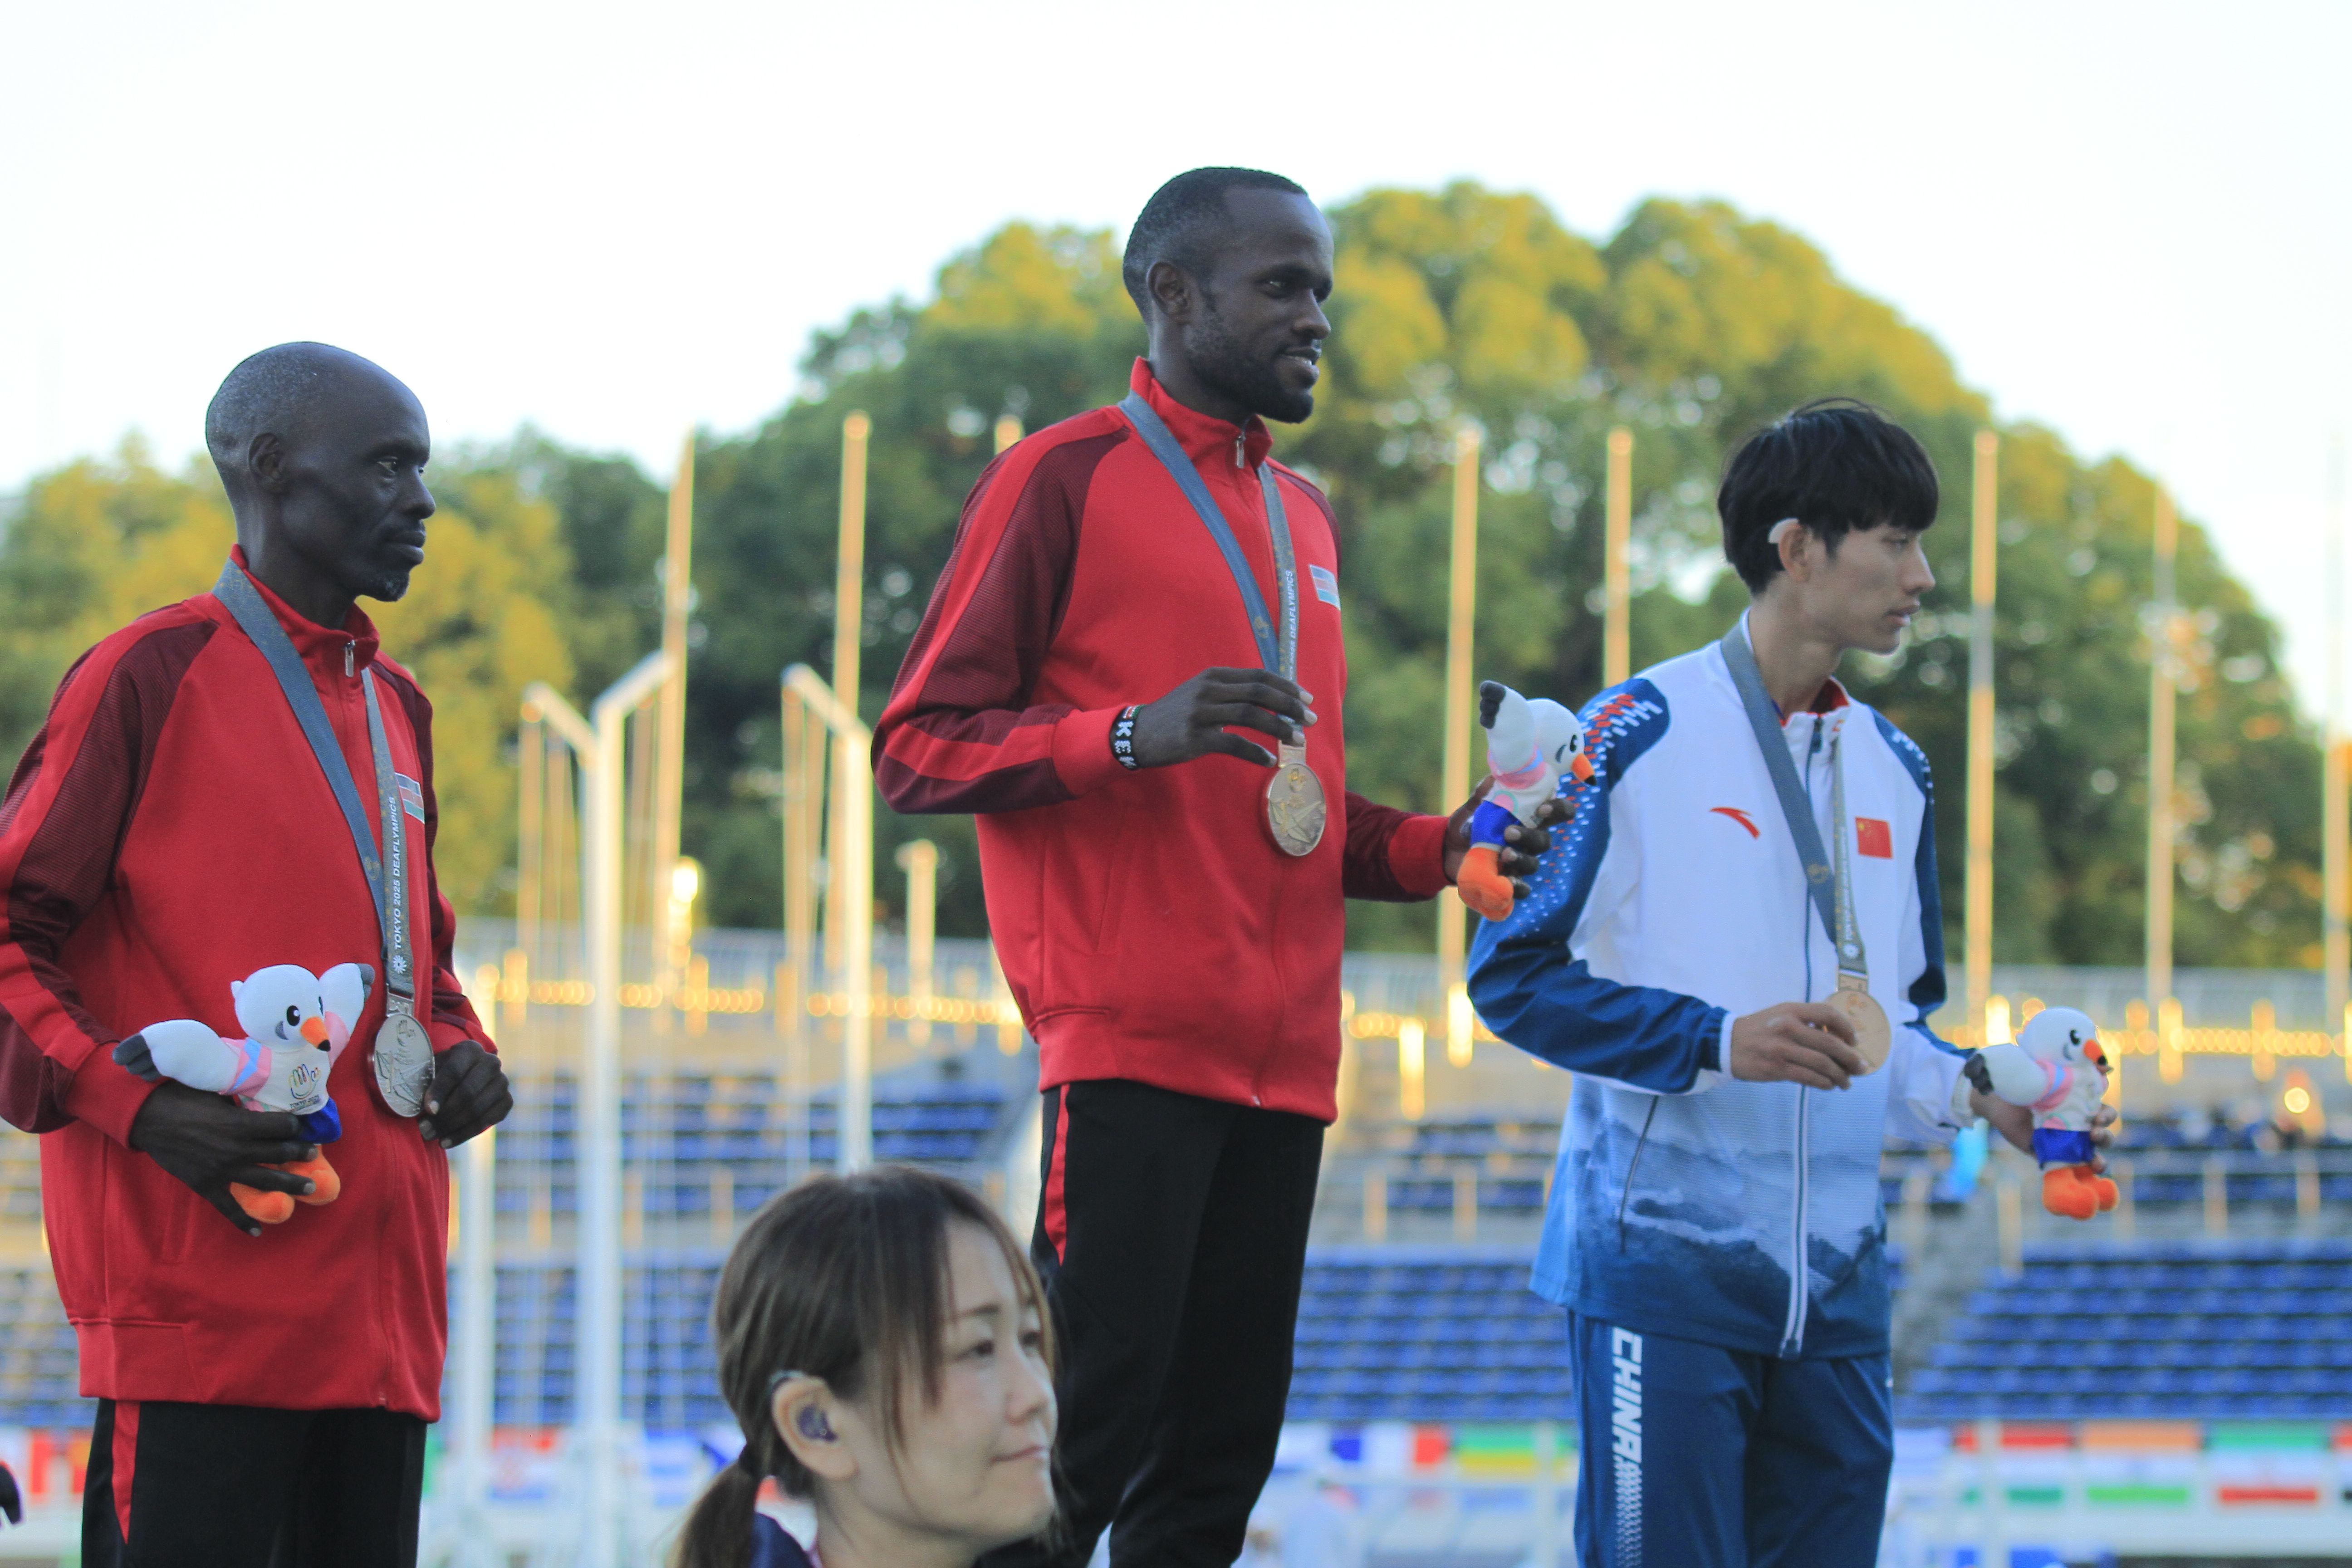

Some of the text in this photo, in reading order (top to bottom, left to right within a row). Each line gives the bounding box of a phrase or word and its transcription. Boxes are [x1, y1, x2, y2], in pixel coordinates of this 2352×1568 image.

[1285, 570, 1296, 639] DEAFLYMPICS
[389, 797, 400, 877] DEAFLYMPICS
[1612, 1326, 1643, 1463] CHINA
